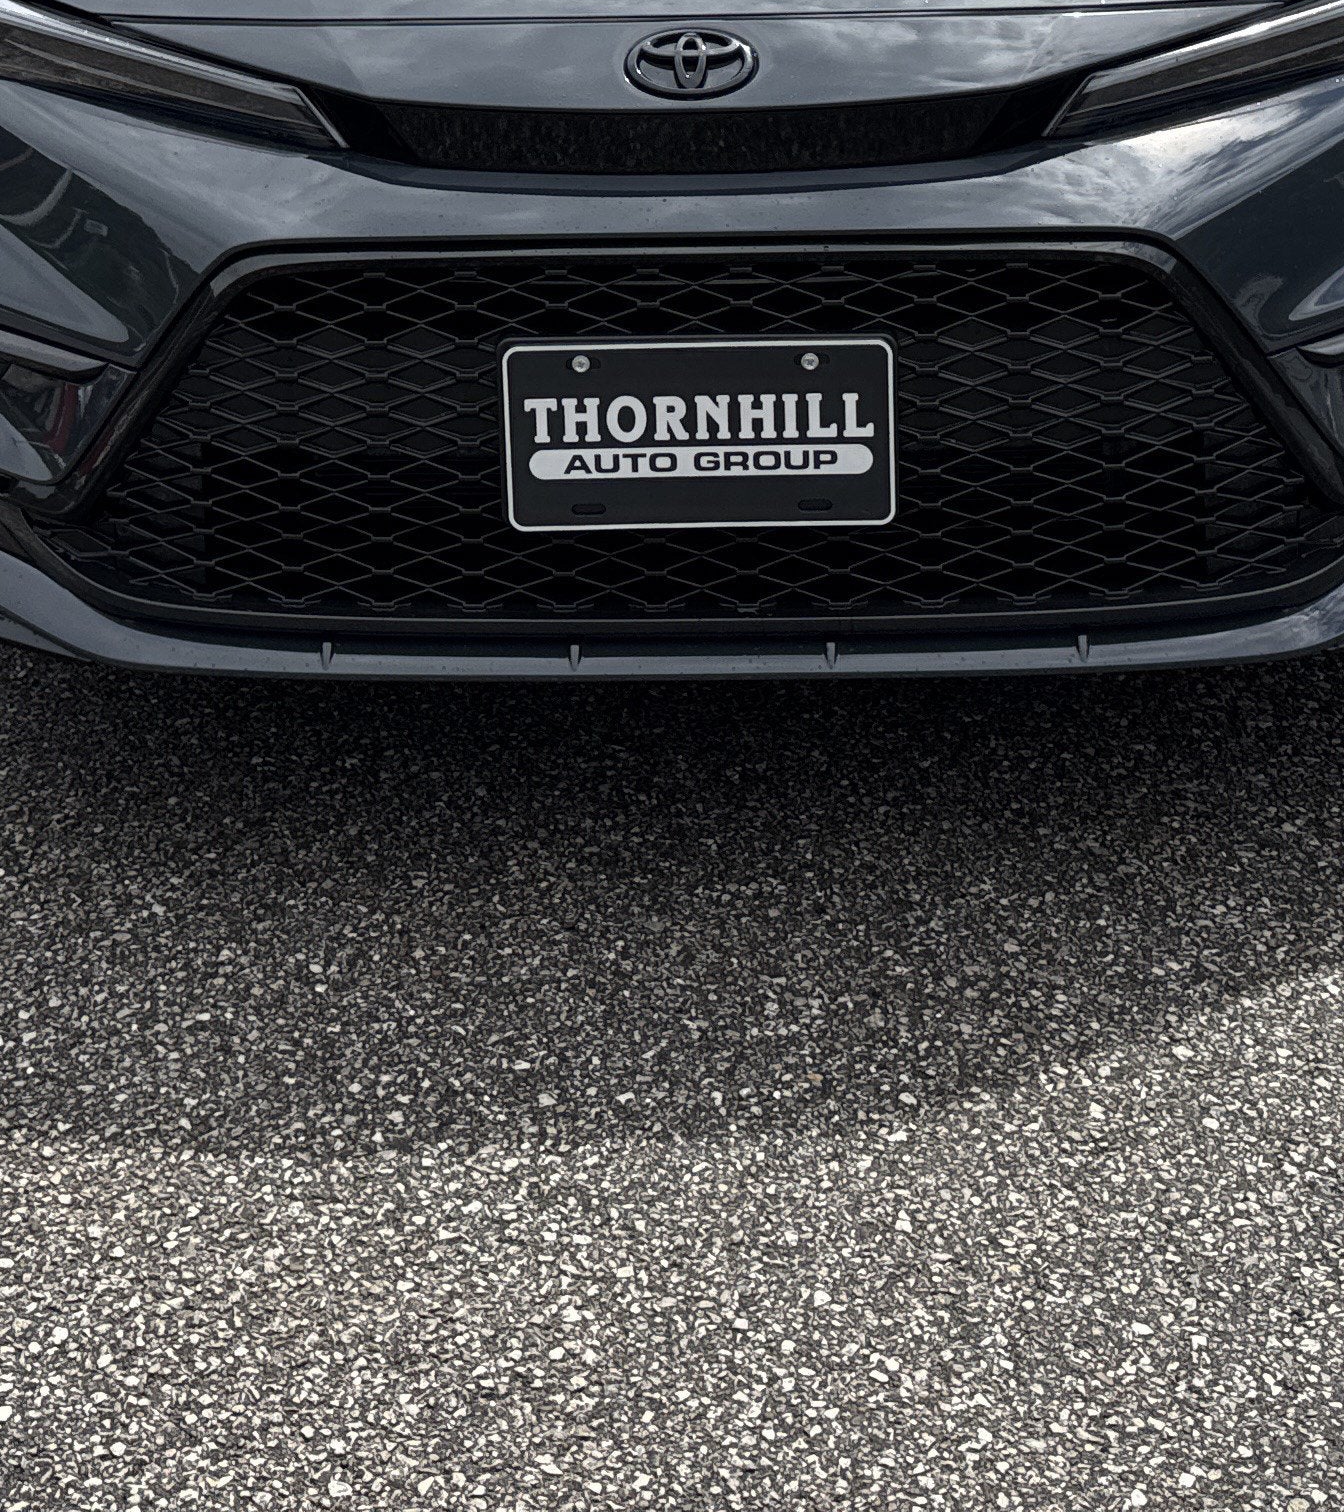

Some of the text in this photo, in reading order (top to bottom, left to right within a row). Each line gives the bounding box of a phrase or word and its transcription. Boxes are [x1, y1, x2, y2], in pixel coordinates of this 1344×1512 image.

[523, 392, 875, 444] THORNHILL
[563, 449, 839, 475] AUTO GROUP
